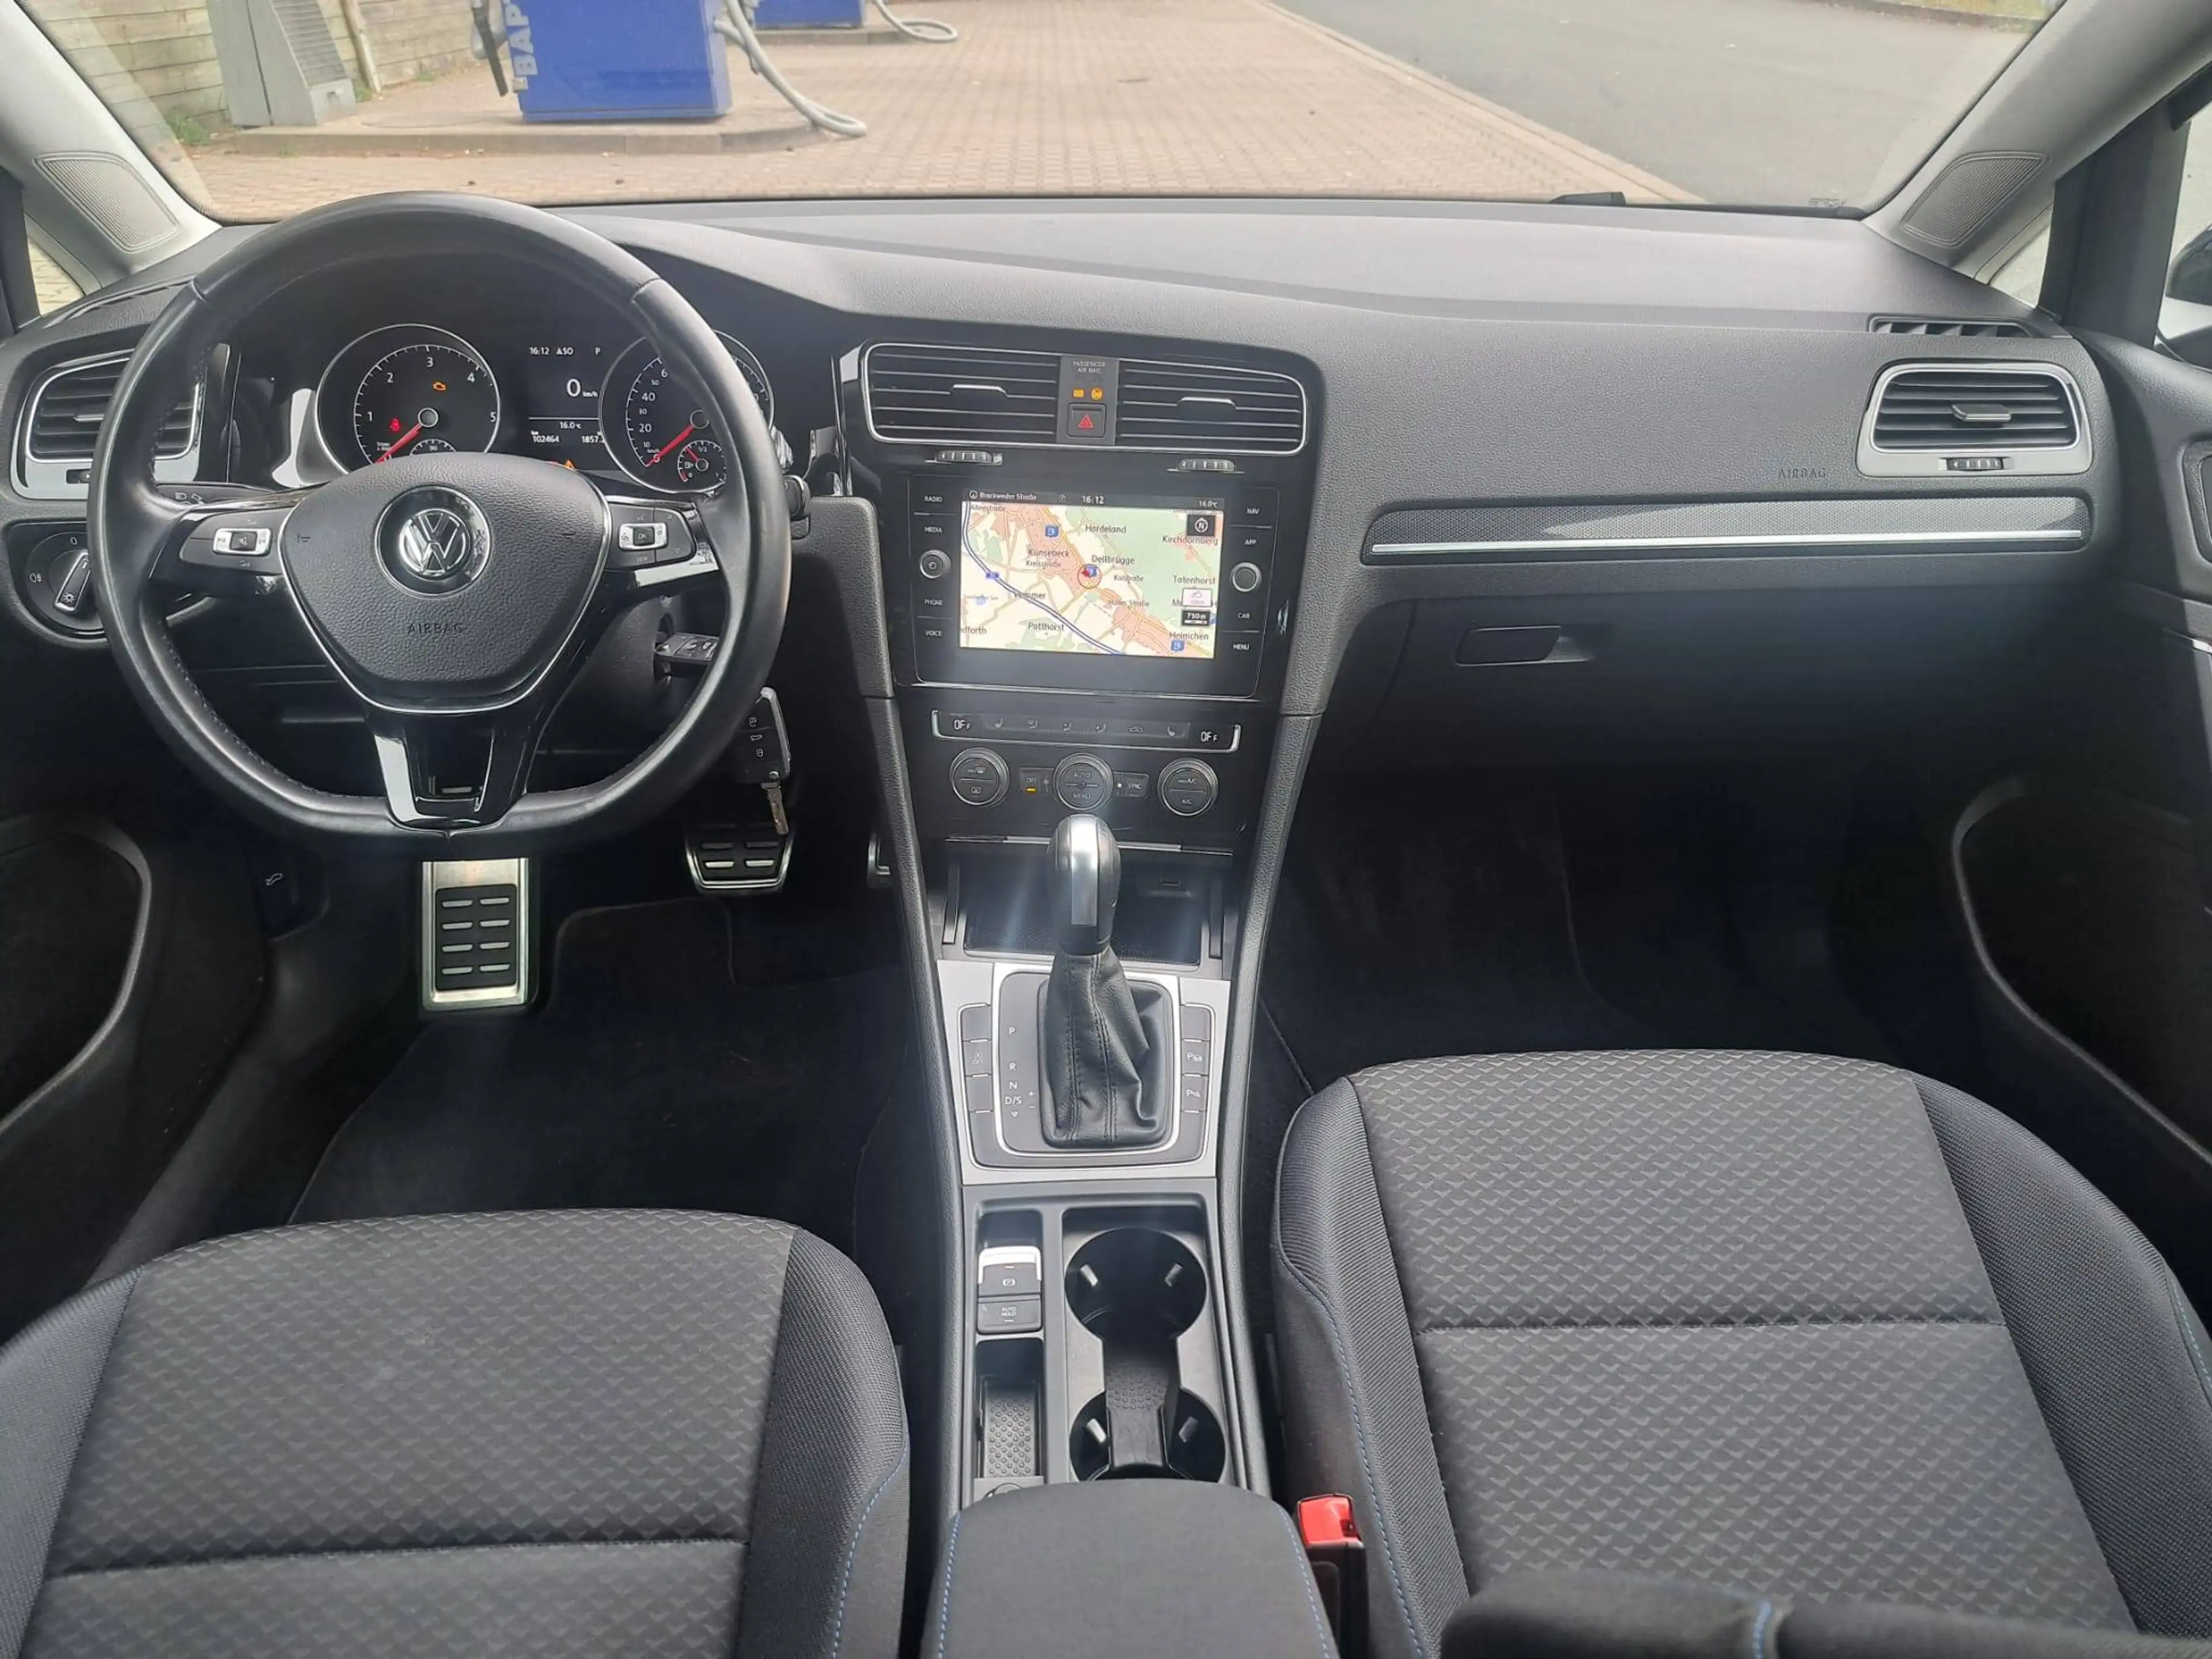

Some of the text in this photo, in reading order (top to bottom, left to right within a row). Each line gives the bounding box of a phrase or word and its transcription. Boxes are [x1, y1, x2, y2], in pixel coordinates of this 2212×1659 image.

[529, 347, 550, 355] 16:12
[595, 347, 601, 355] P
[426, 356, 434, 368] 3
[387, 372, 394, 383] 2
[467, 372, 476, 383] 4
[566, 378, 581, 397] 0
[641, 392, 656, 402] 40
[368, 411, 373, 422] 1
[490, 411, 497, 422] 5
[639, 423, 652, 433] 20
[1778, 468, 1827, 478] AIRBAG
[1082, 495, 1105, 505] 16:12
[1085, 523, 1127, 535] Hardeland
[1173, 575, 1215, 585] Tatenhorst
[408, 622, 465, 635] AIRBAG
[1009, 1063, 1017, 1071] R
[1009, 1081, 1018, 1090] N
[1004, 1096, 1022, 1105] D/S
